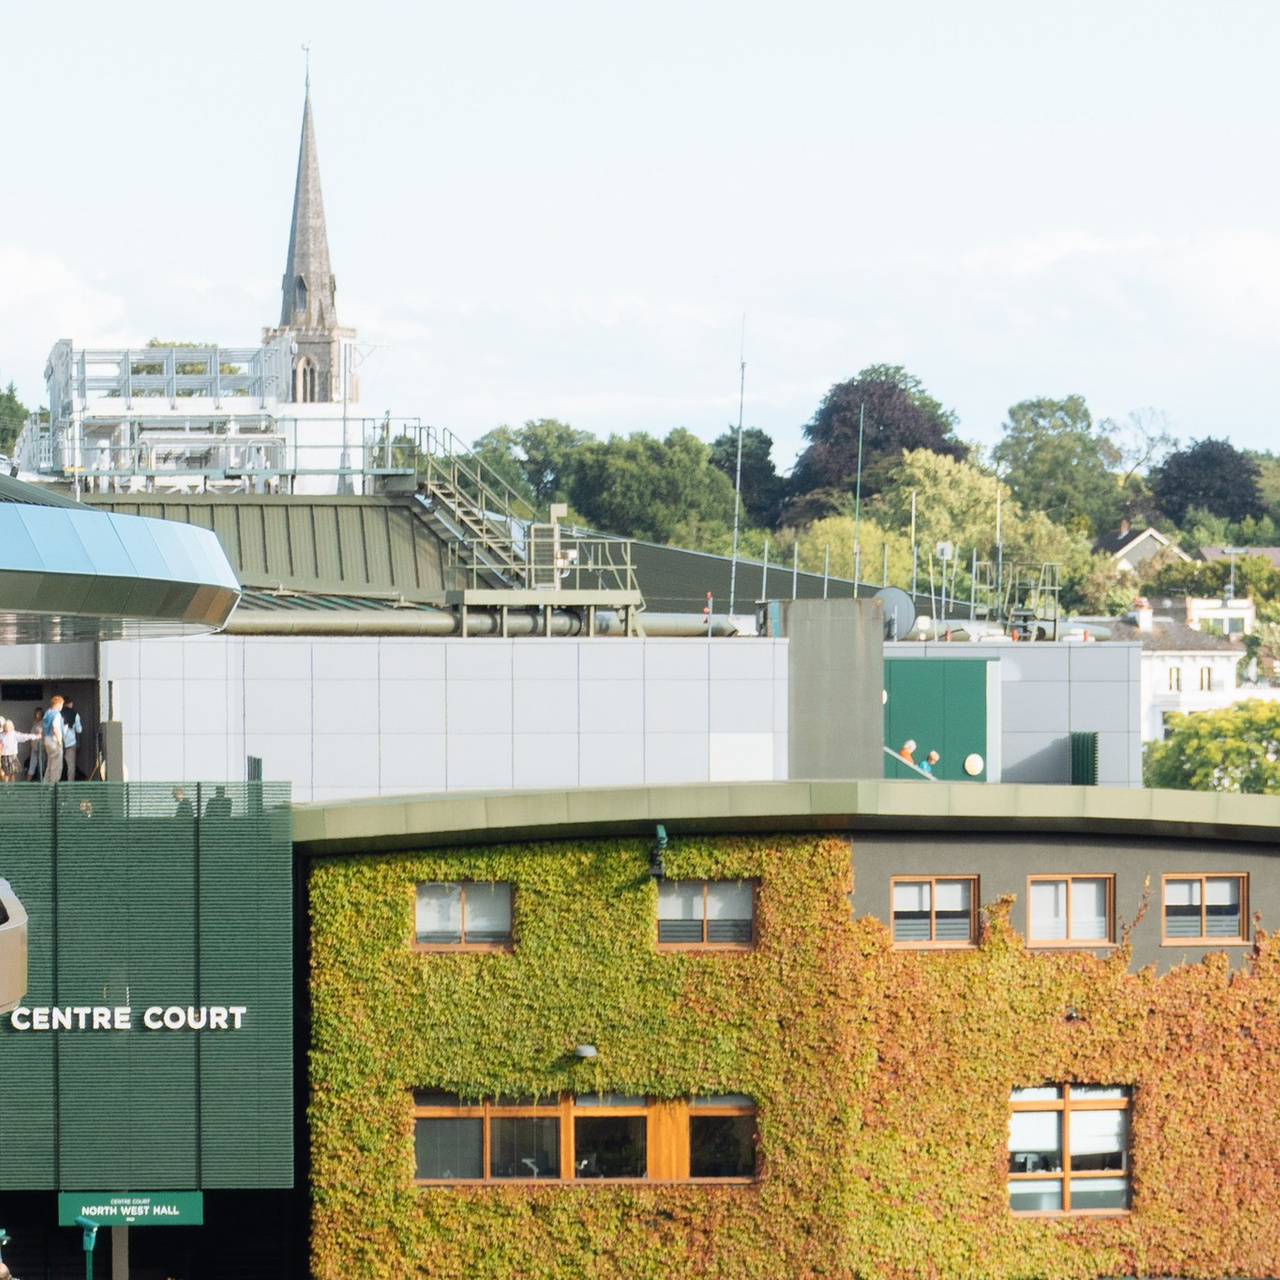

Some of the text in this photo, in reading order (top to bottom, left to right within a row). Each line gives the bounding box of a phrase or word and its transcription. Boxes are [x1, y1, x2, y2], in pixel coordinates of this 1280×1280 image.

[11, 1006, 247, 1030] CENTRE COURT
[81, 1205, 179, 1216] NORTH WEST HALL
